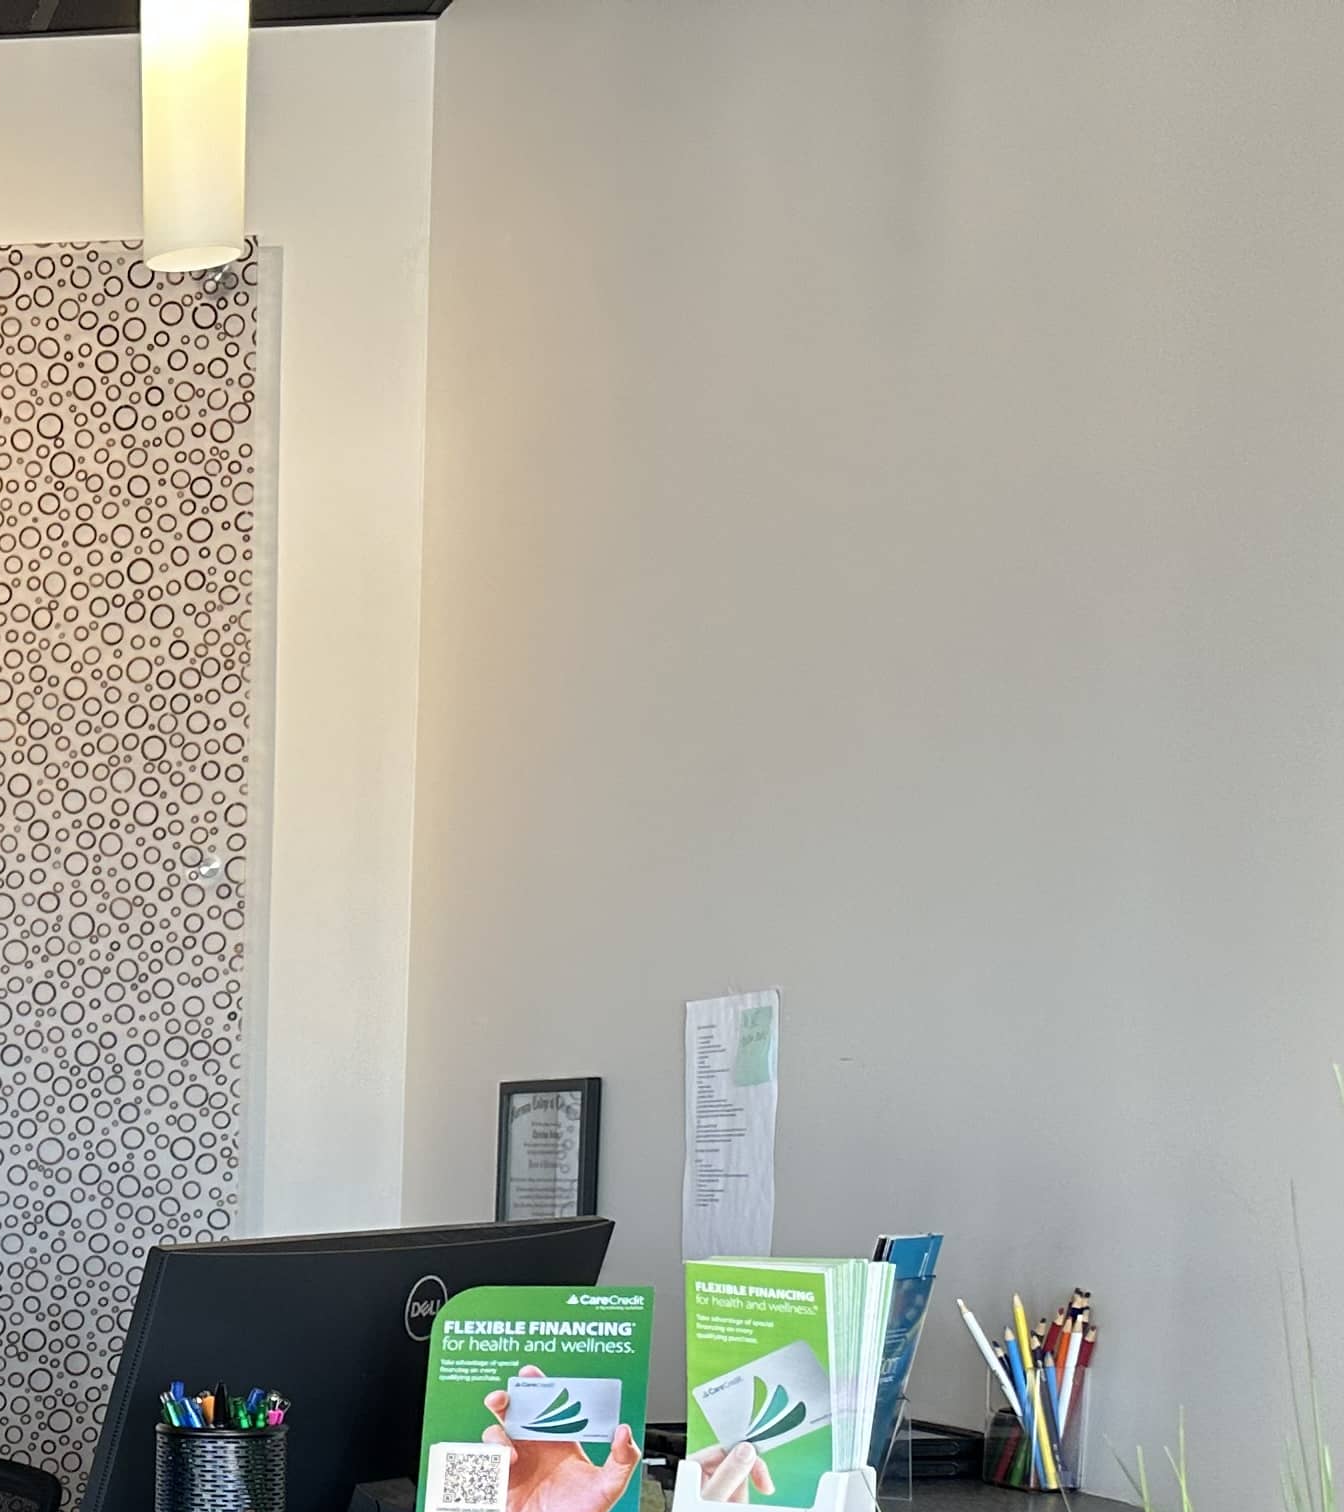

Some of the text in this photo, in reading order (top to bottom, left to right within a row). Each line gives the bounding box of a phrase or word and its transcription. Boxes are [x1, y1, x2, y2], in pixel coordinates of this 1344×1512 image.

[580, 1294, 645, 1306] CareCredit
[695, 1281, 815, 1302] FLEXIBLE FINANCING
[410, 1299, 441, 1318] DELL
[695, 1294, 709, 1305] for
[712, 1295, 744, 1309] health
[746, 1299, 767, 1312] and
[444, 1320, 526, 1336] FLEXIBLE
[442, 1336, 635, 1354] for health and wellness.
